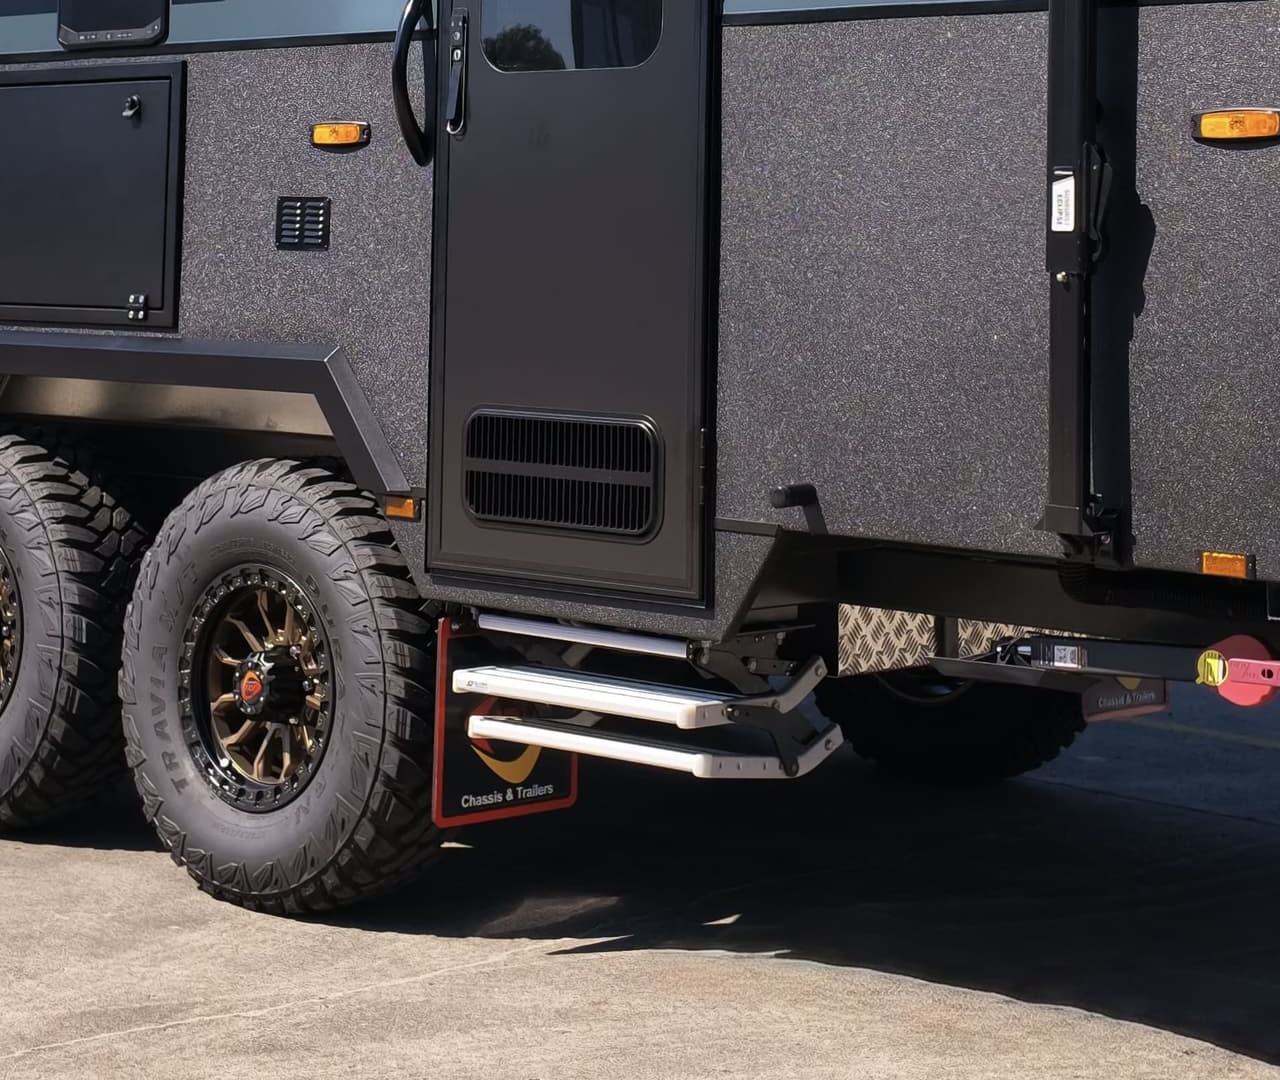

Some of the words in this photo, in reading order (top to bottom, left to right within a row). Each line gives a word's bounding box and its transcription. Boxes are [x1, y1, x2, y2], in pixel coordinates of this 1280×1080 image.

[151, 646, 188, 795] TRAVIA
[461, 789, 503, 808] Chassis
[505, 787, 514, 801] &
[516, 783, 554, 800] Trailers
